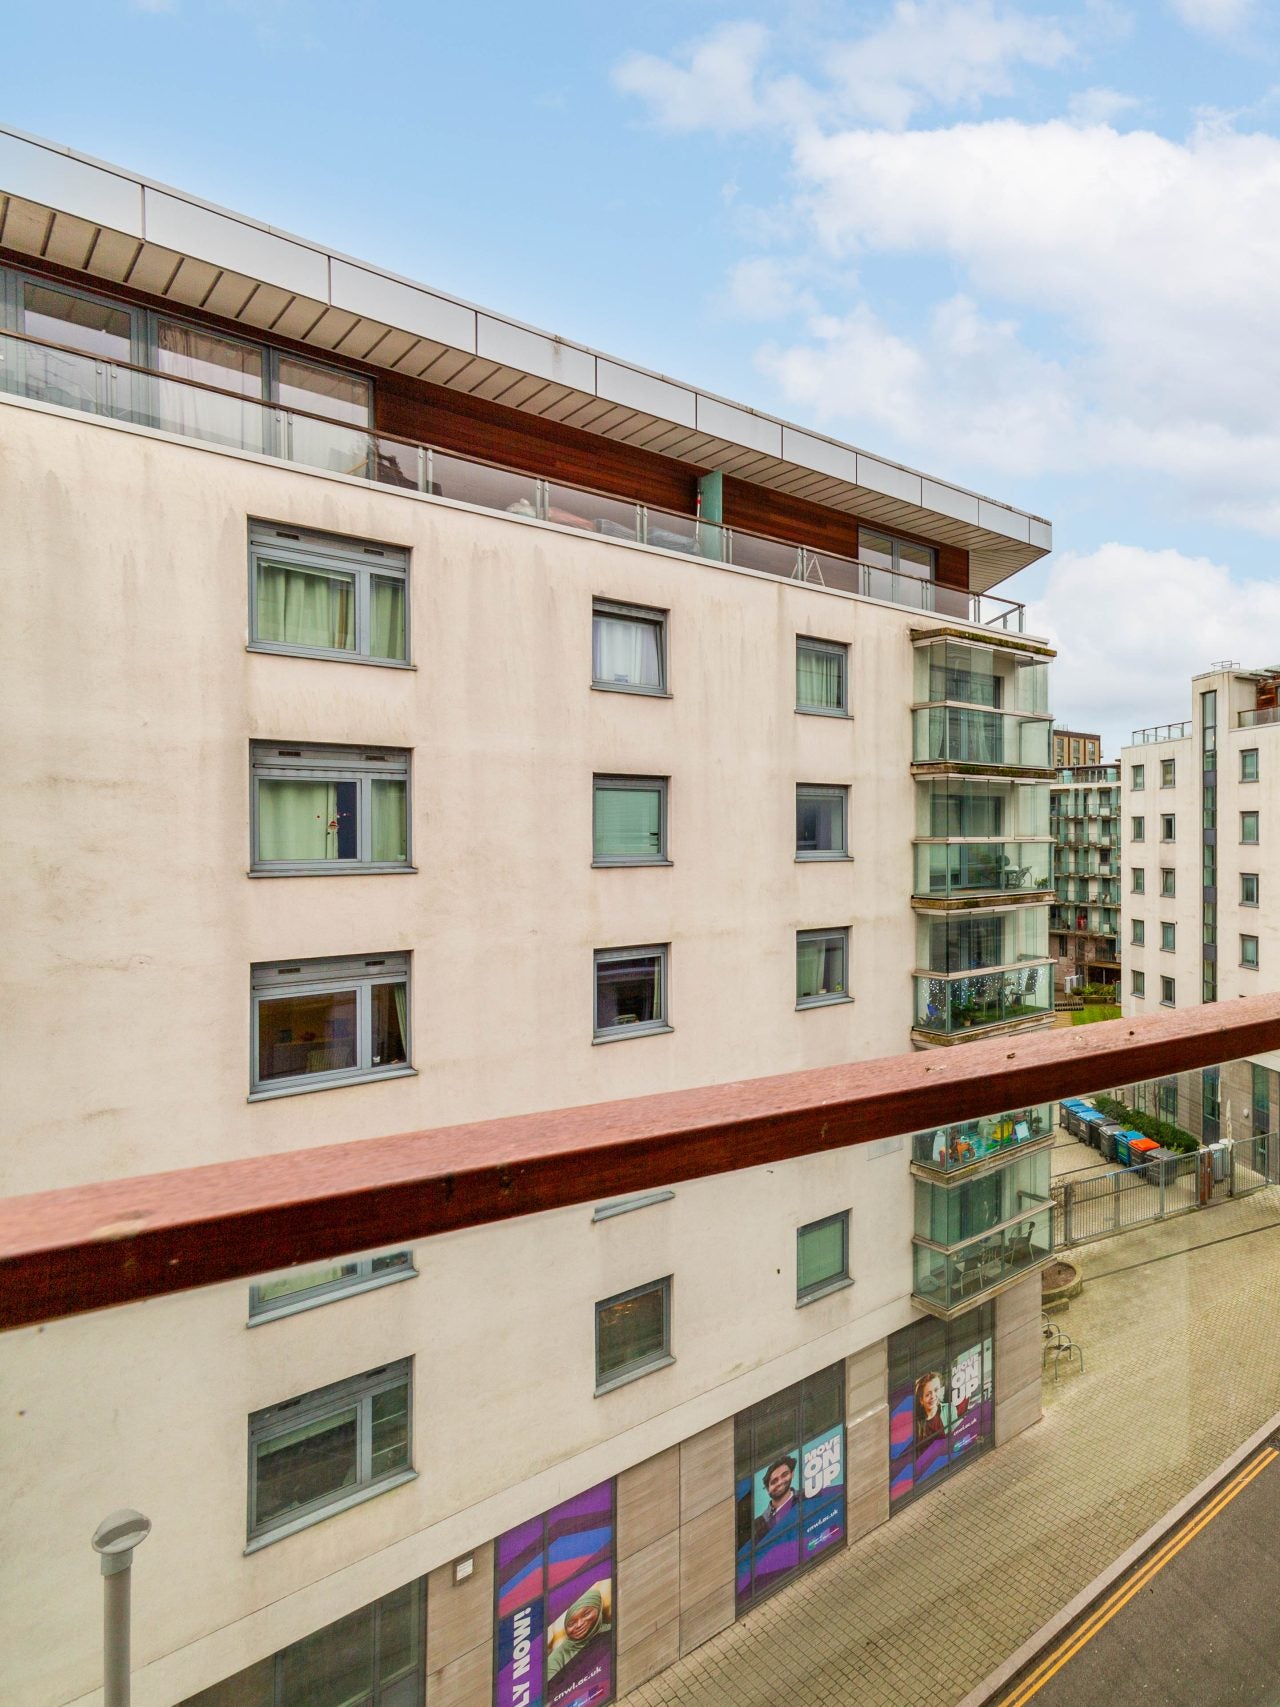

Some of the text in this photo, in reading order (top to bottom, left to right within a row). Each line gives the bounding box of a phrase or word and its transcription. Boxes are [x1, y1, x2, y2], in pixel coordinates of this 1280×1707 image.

[951, 1361, 980, 1389] ON
[951, 1379, 980, 1407] UP
[804, 1434, 841, 1464] MOVE
[804, 1443, 841, 1479] ON
[804, 1462, 841, 1499] UP
[512, 1607, 532, 1680] NOW!
